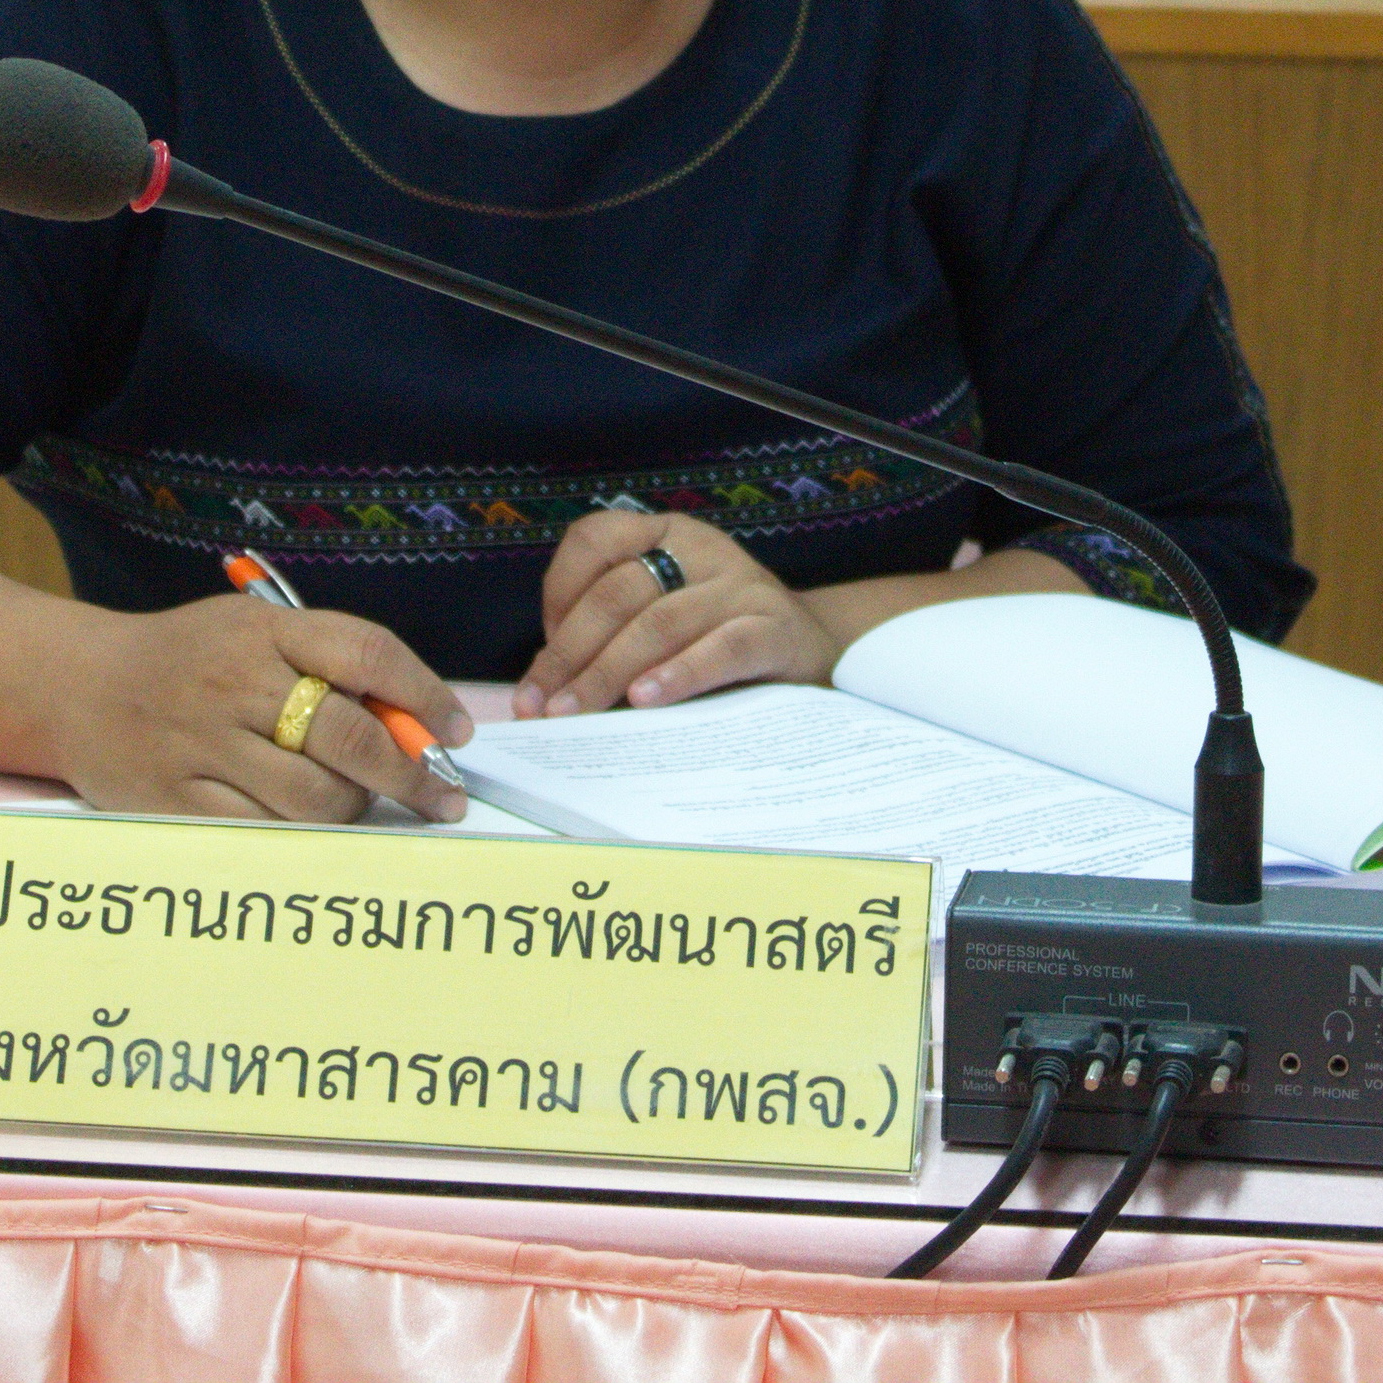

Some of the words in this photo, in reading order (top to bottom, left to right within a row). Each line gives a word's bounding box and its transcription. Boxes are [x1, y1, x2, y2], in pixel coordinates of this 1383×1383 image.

[966, 943, 1080, 961] PROFESSIONAL
[965, 958, 1067, 976] CONFERENCE
[1072, 964, 1135, 980] SYSTEM
[1108, 993, 1147, 1008] LINE
[1364, 1062, 1383, 1072] MIN
[619, 1049, 900, 1138] (กพสจ.)
[963, 1081, 995, 1093] Made
[1274, 1084, 1303, 1096] REC
[1312, 1087, 1361, 1100] PHONE
